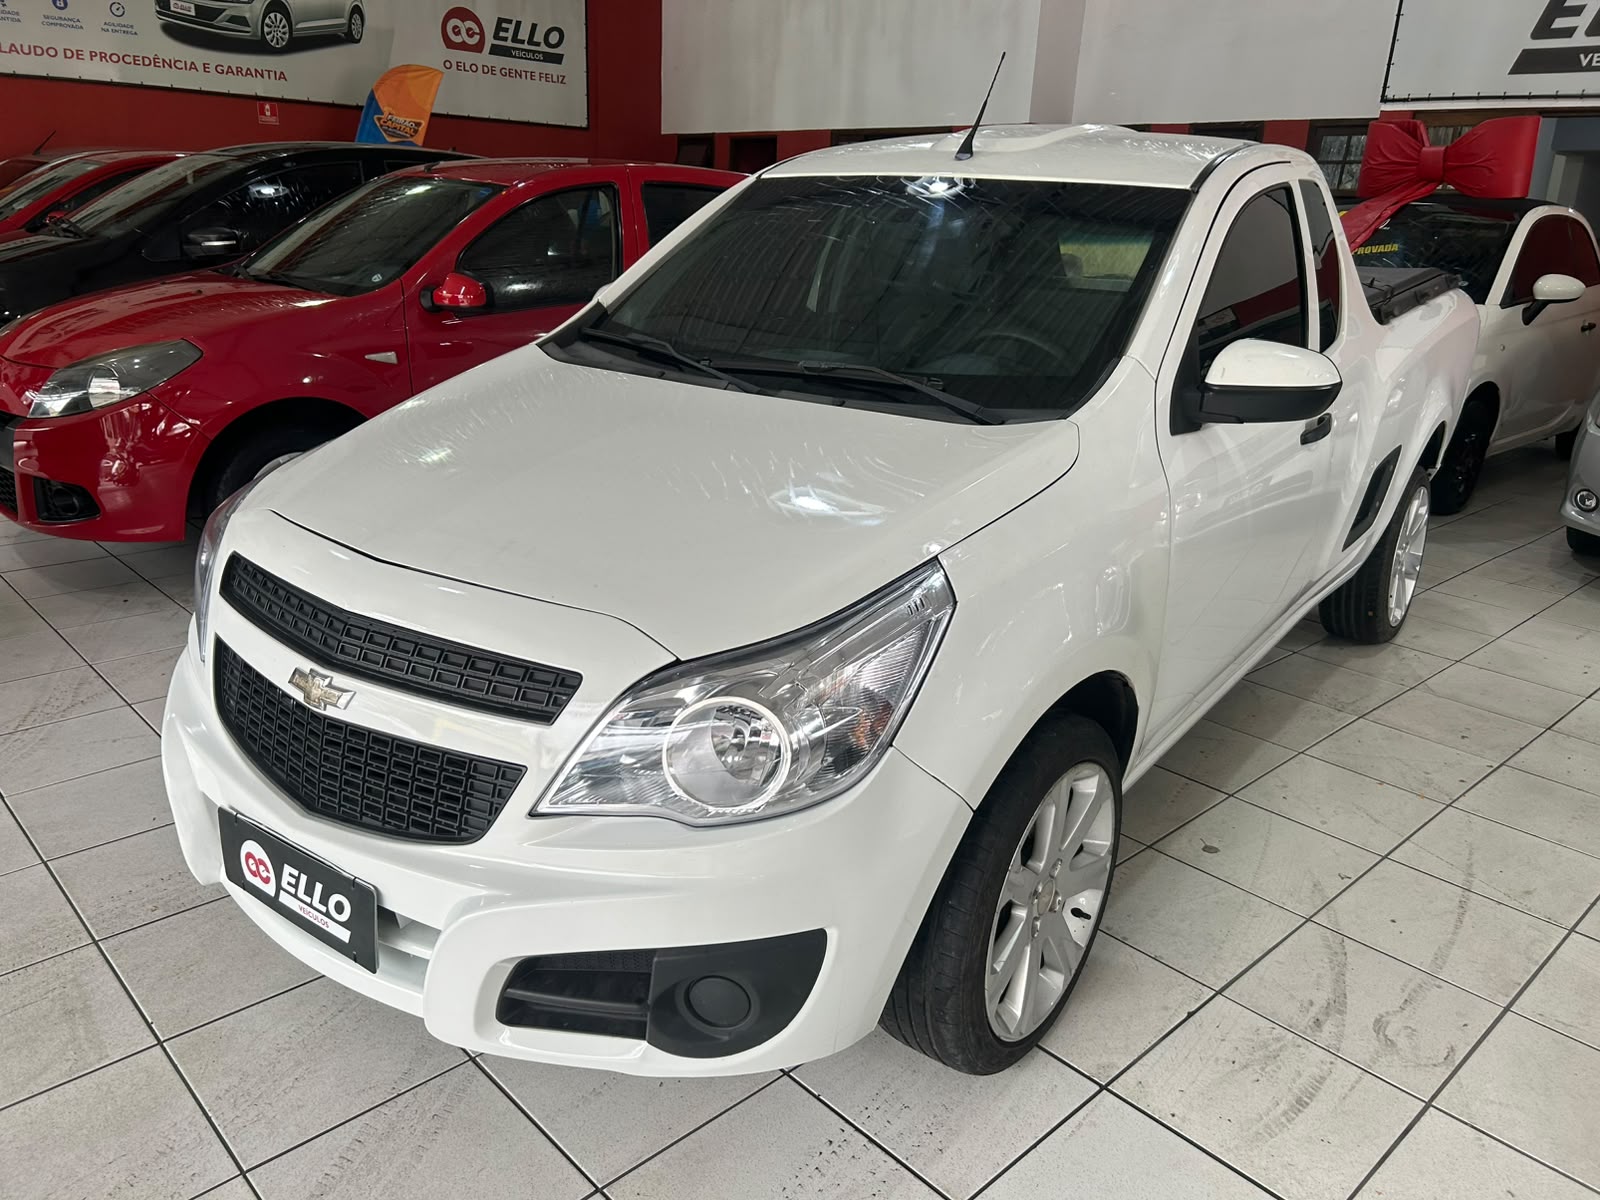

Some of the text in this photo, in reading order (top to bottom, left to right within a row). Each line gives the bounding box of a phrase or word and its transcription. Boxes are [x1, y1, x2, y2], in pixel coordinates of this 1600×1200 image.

[41, 20, 84, 30] COMPROVADA
[42, 14, 81, 23] SEGURANÇA
[103, 21, 135, 29] AGILIDADE
[111, 28, 138, 36] ENTREGA
[492, 16, 565, 49] ELLO
[0, 42, 288, 81] LAUDO DE PROCEDÊNCIA E GARANTIA
[511, 49, 544, 60] VEÍCULOS
[443, 59, 567, 84] O ELO DE GENTE FELIZ
[280, 863, 351, 923] ELLO
[298, 904, 330, 929] VEÍCULOS
